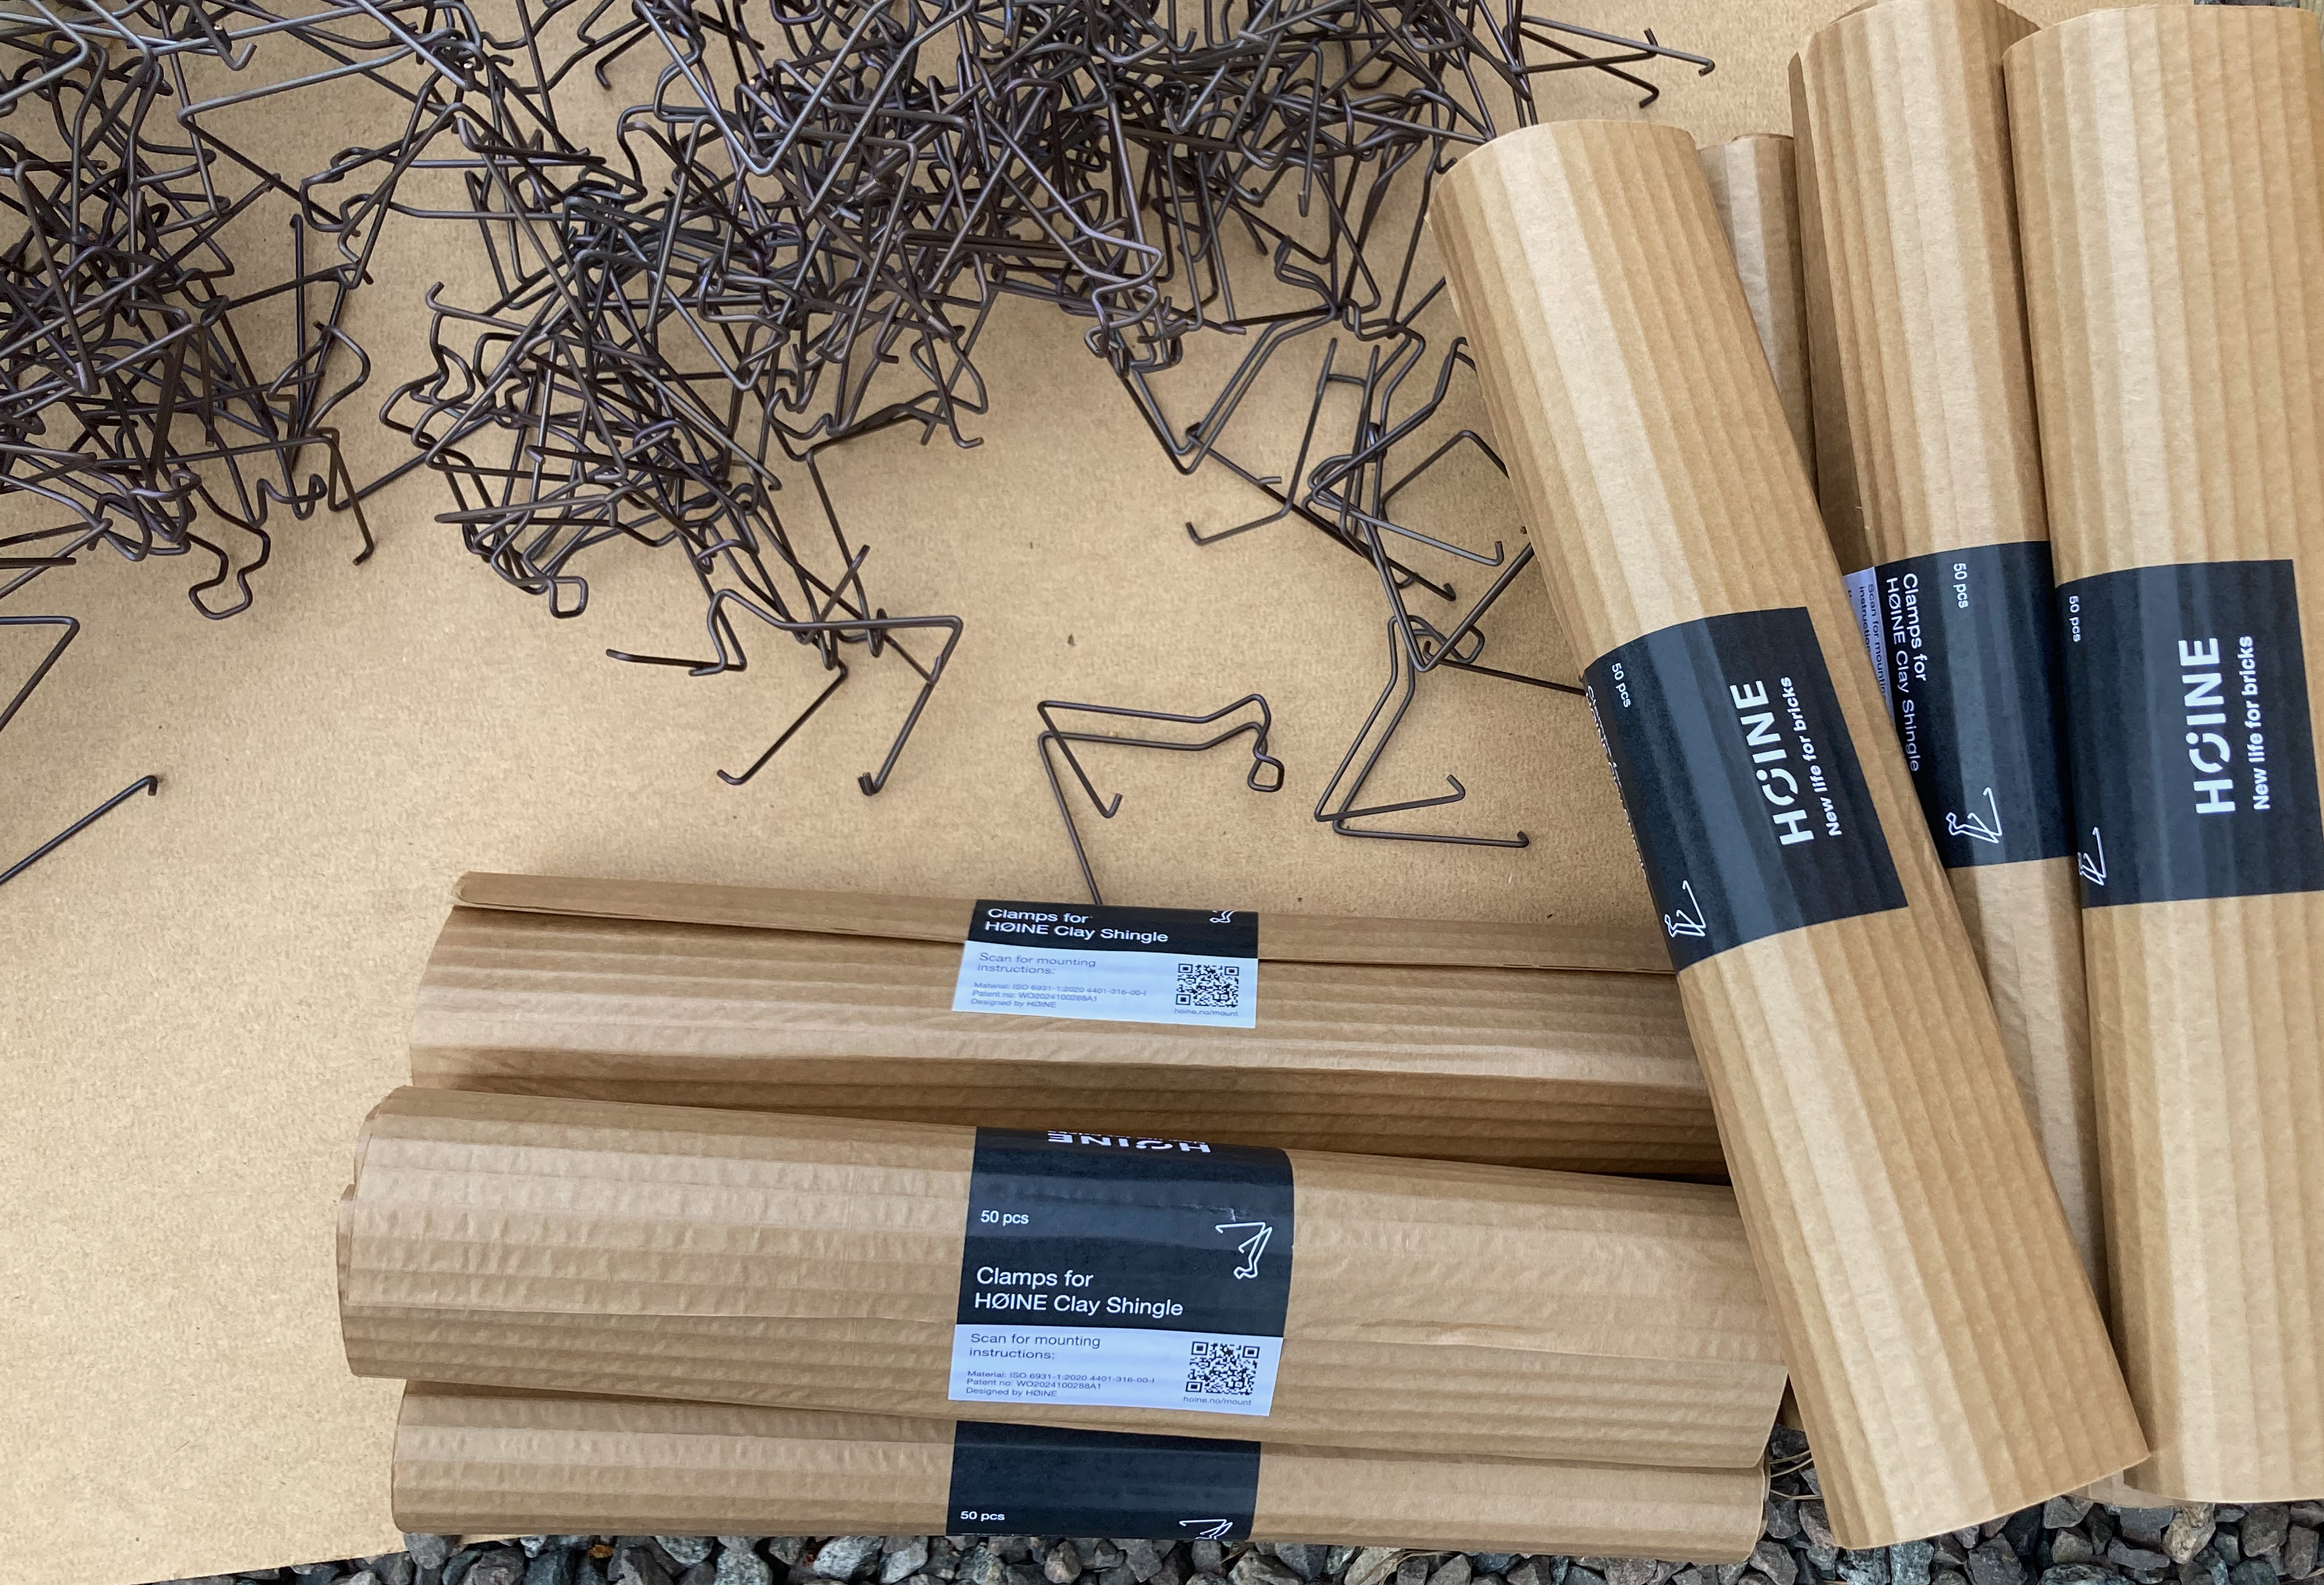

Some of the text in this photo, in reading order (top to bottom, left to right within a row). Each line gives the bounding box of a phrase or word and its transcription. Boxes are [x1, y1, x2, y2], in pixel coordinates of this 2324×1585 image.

[1953, 562, 1969, 608] 50 pcs
[1902, 573, 1927, 681] Clamps for
[2069, 596, 2081, 642] 50 pcs
[1868, 584, 1877, 617] Scan
[1875, 642, 1886, 696] mountin
[1886, 578, 1921, 772] HØINE Clay Shingle
[1611, 663, 1631, 708] 50 pcs
[2238, 635, 2270, 810] New life for bricks
[1780, 676, 1842, 837] New life for bricks
[987, 908, 1088, 923] Clamps for
[985, 920, 1169, 943] HØINE Clay Shingle
[977, 964, 1056, 975] instructions:
[979, 952, 1096, 968] Scan for mounting
[974, 982, 1009, 990] Material:
[971, 998, 1011, 1007] Designed
[980, 1209, 1029, 1227] 50 pcs
[976, 1266, 1094, 1289] Clamps for
[975, 1292, 1183, 1319] HØINE Clay Shingle
[971, 1333, 1100, 1350] Scan for mounting
[969, 1347, 1055, 1360] instructions:
[966, 1387, 1009, 1395] Designed
[1183, 1395, 1252, 1406] hoine.no/mount
[960, 1511, 1005, 1522] 50 pcs
